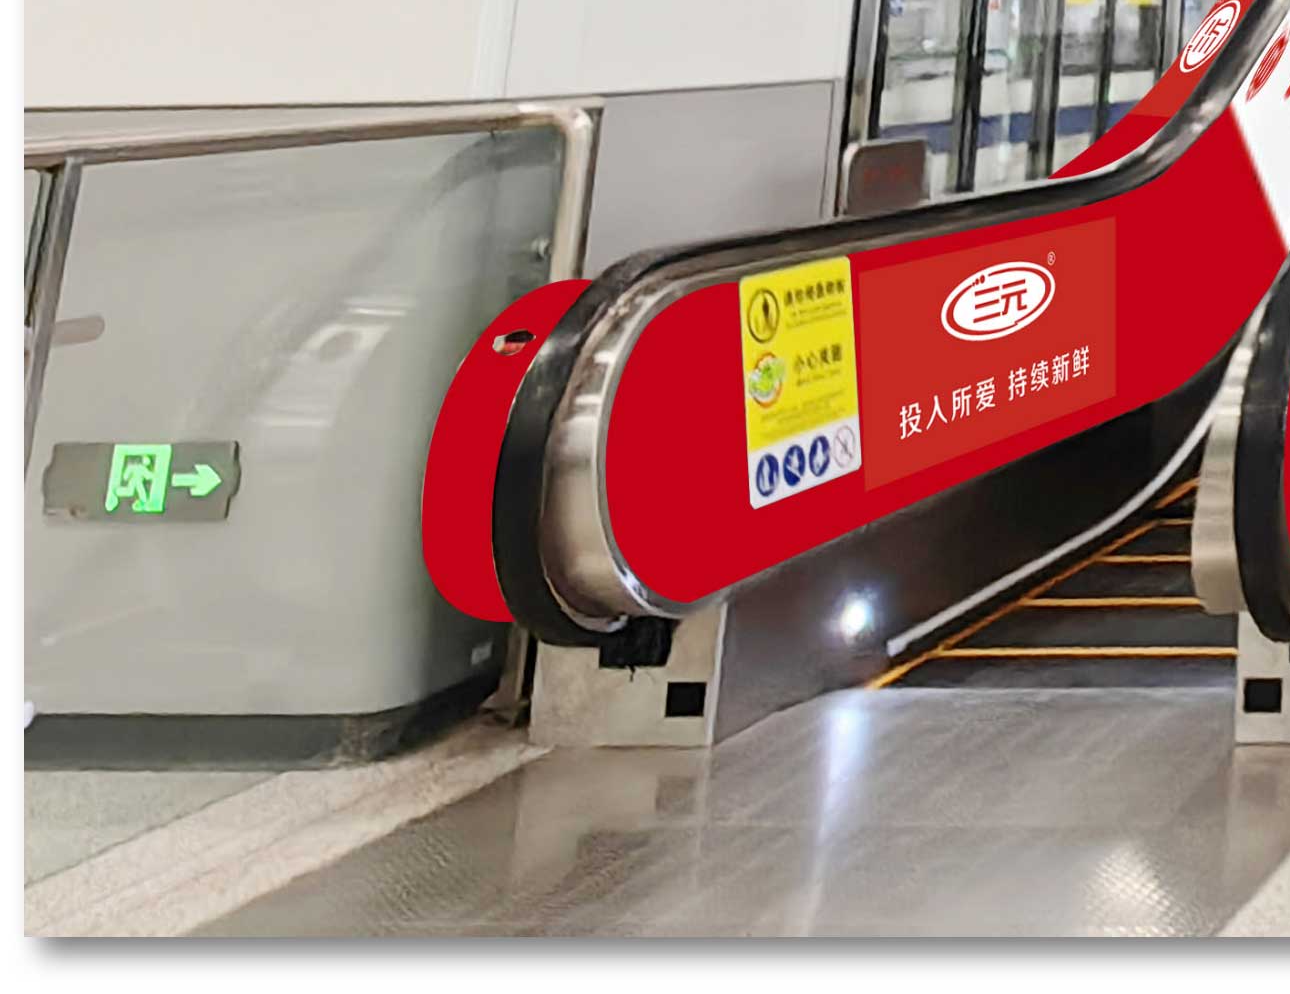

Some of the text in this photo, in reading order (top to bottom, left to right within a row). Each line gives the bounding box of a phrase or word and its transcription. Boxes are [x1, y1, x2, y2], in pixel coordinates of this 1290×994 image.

[899, 345, 1090, 441] 投人所爱 持续新鲜
